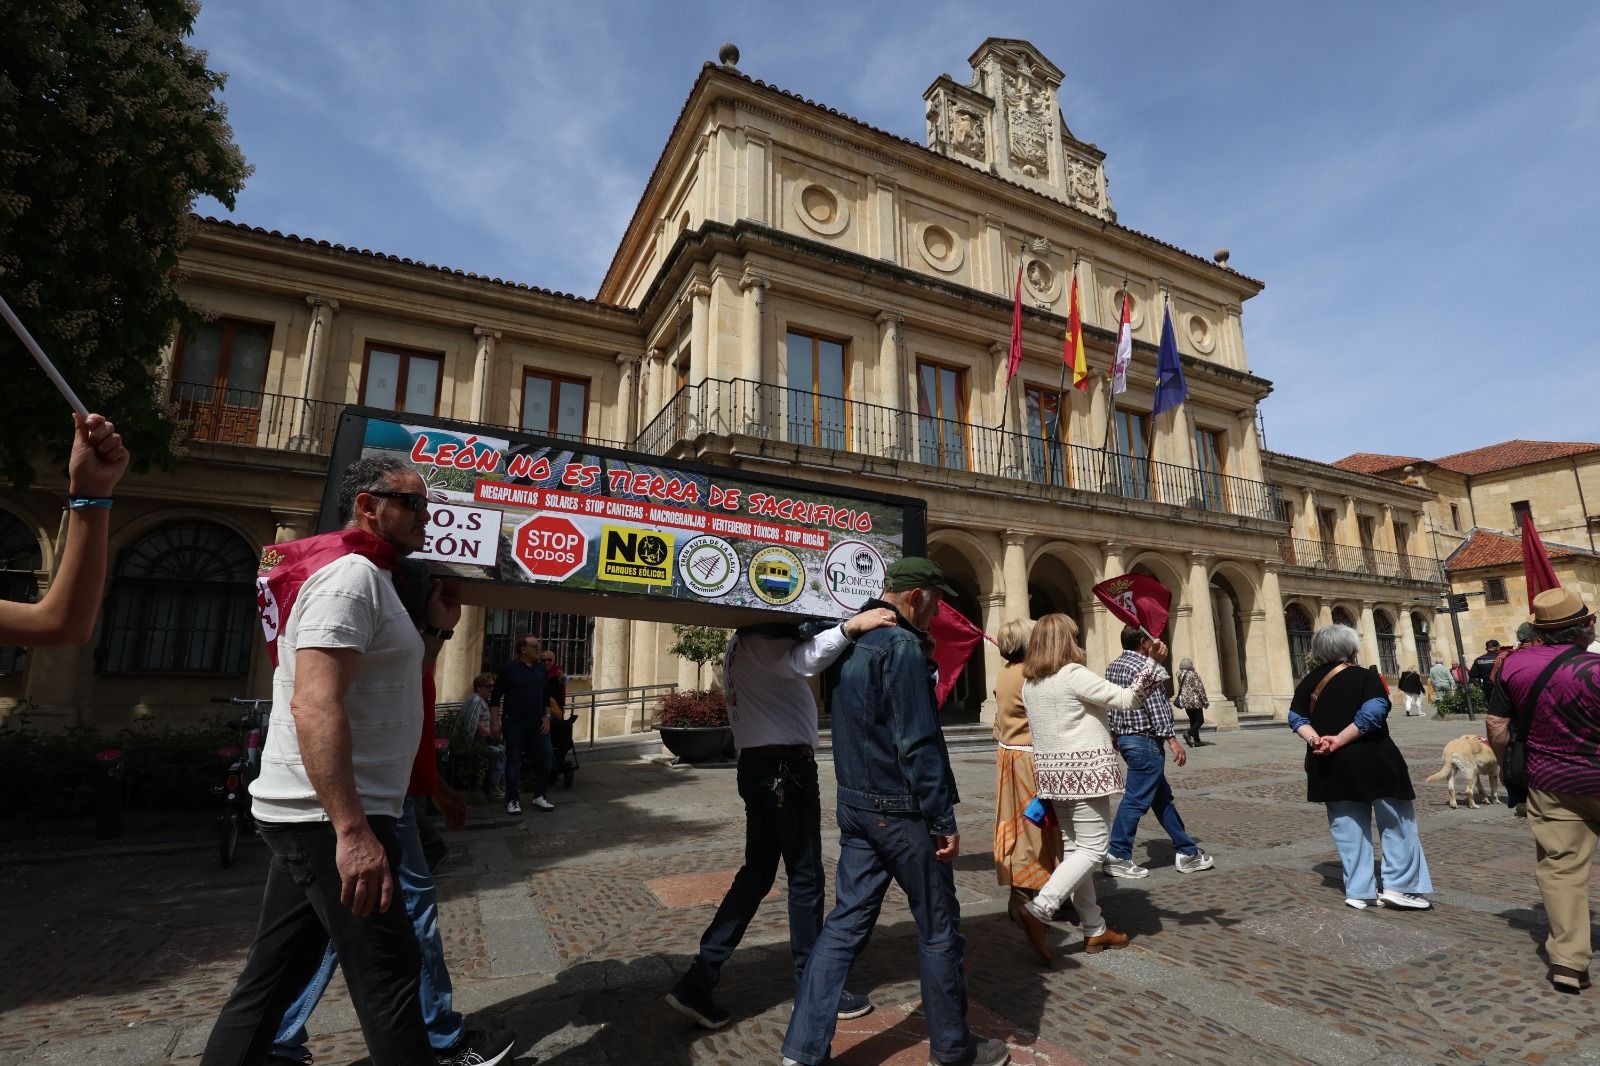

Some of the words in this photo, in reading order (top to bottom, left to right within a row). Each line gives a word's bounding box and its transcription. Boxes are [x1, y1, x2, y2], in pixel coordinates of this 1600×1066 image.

[410, 434, 501, 473] LEÓN
[507, 453, 551, 481] NO
[561, 463, 601, 487] ES
[607, 469, 700, 503] TIERRA
[708, 484, 741, 510] DE
[748, 493, 872, 532] SACRIFICIO
[432, 508, 482, 531] O.S
[480, 484, 538, 505] MEGAPLANTAS
[545, 493, 579, 510] SOLARES
[585, 499, 604, 513] STOP
[606, 502, 643, 519] CANTERAS
[649, 508, 706, 529] MACROGRANJAS
[712, 517, 751, 536] VERTEDEROS
[753, 523, 779, 540] TÓXICOS
[784, 530, 801, 543] STOP
[802, 532, 825, 547] BIOGÁS
[422, 532, 481, 558] EÓN
[527, 529, 579, 550] STOP
[606, 530, 668, 566] NO
[524, 547, 575, 564] LODOS
[680, 549, 690, 567] TREN
[690, 538, 708, 550] RUTA
[720, 543, 729, 553] LA
[727, 552, 736, 574] PLATA
[606, 564, 638, 576] PARQUES
[638, 566, 665, 579] EÓLICOS
[688, 580, 725, 593] Movimiento
